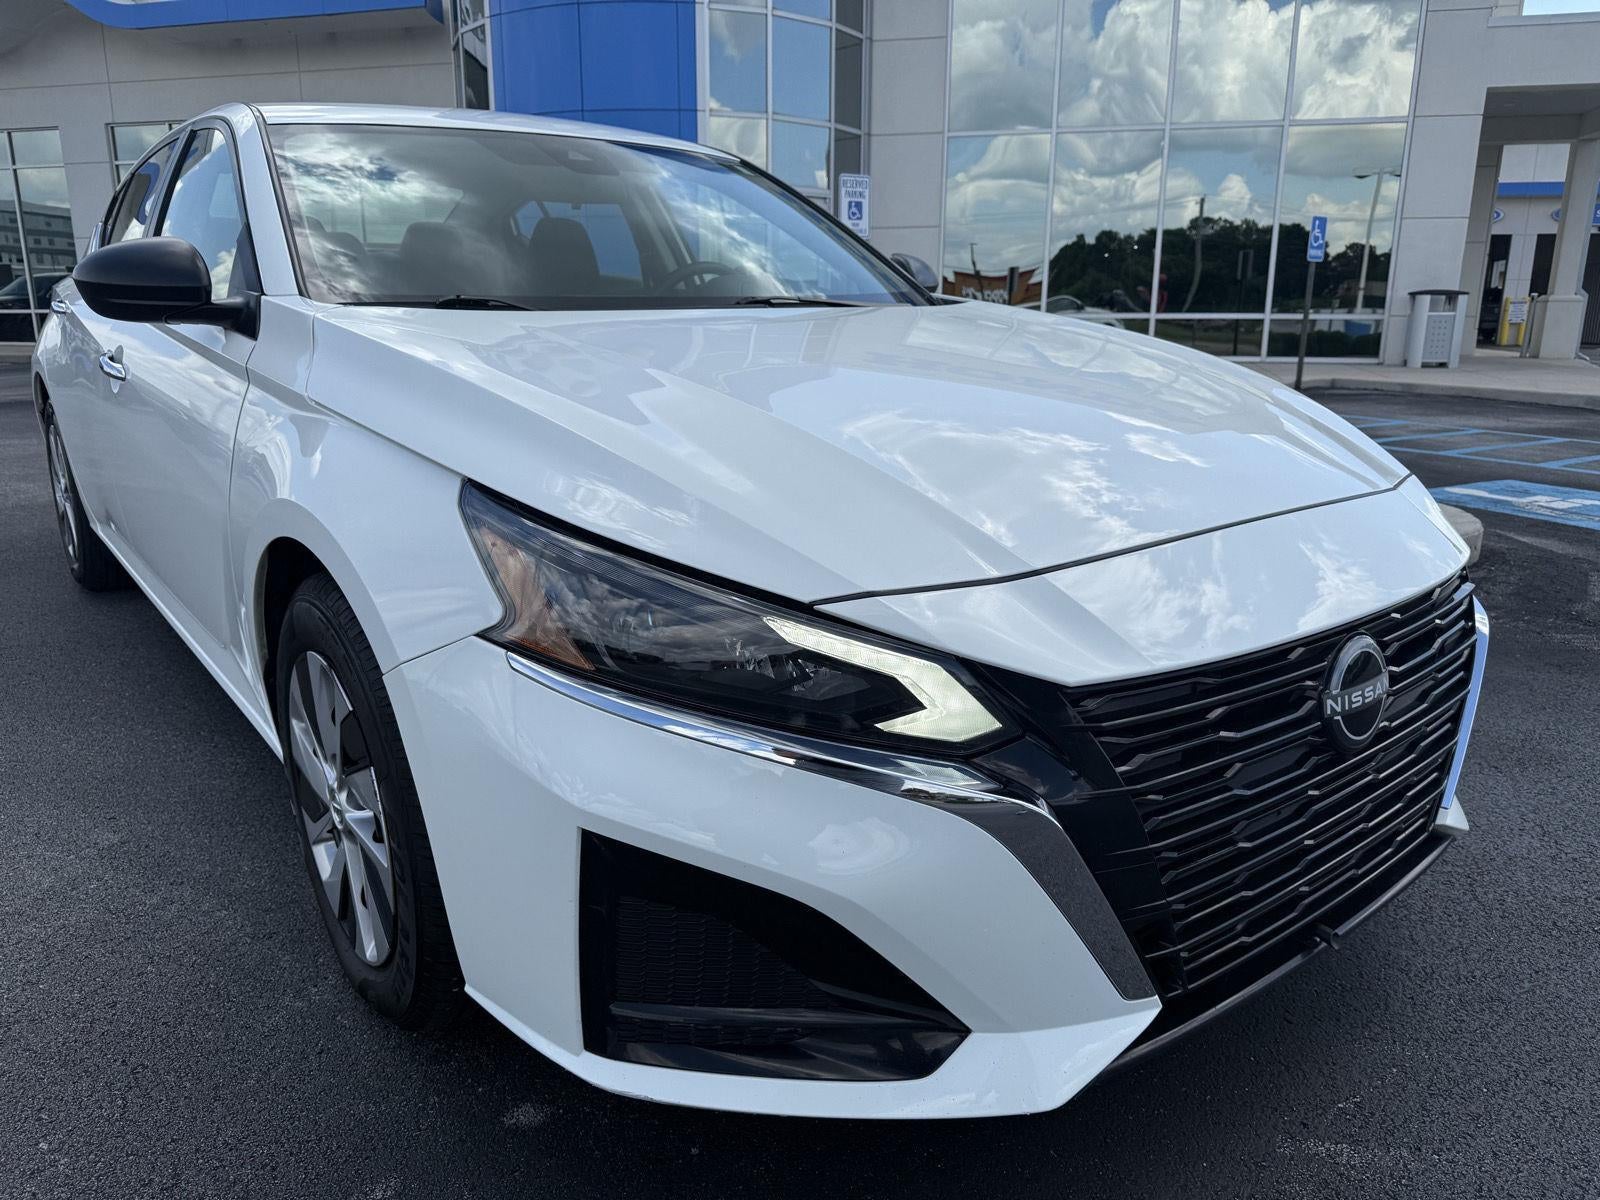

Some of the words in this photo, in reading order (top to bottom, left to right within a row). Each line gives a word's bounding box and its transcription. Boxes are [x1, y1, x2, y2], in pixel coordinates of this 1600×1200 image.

[842, 178, 868, 190] RESERVED
[844, 189, 866, 199] PARKING
[1326, 677, 1389, 714] NISSAN
